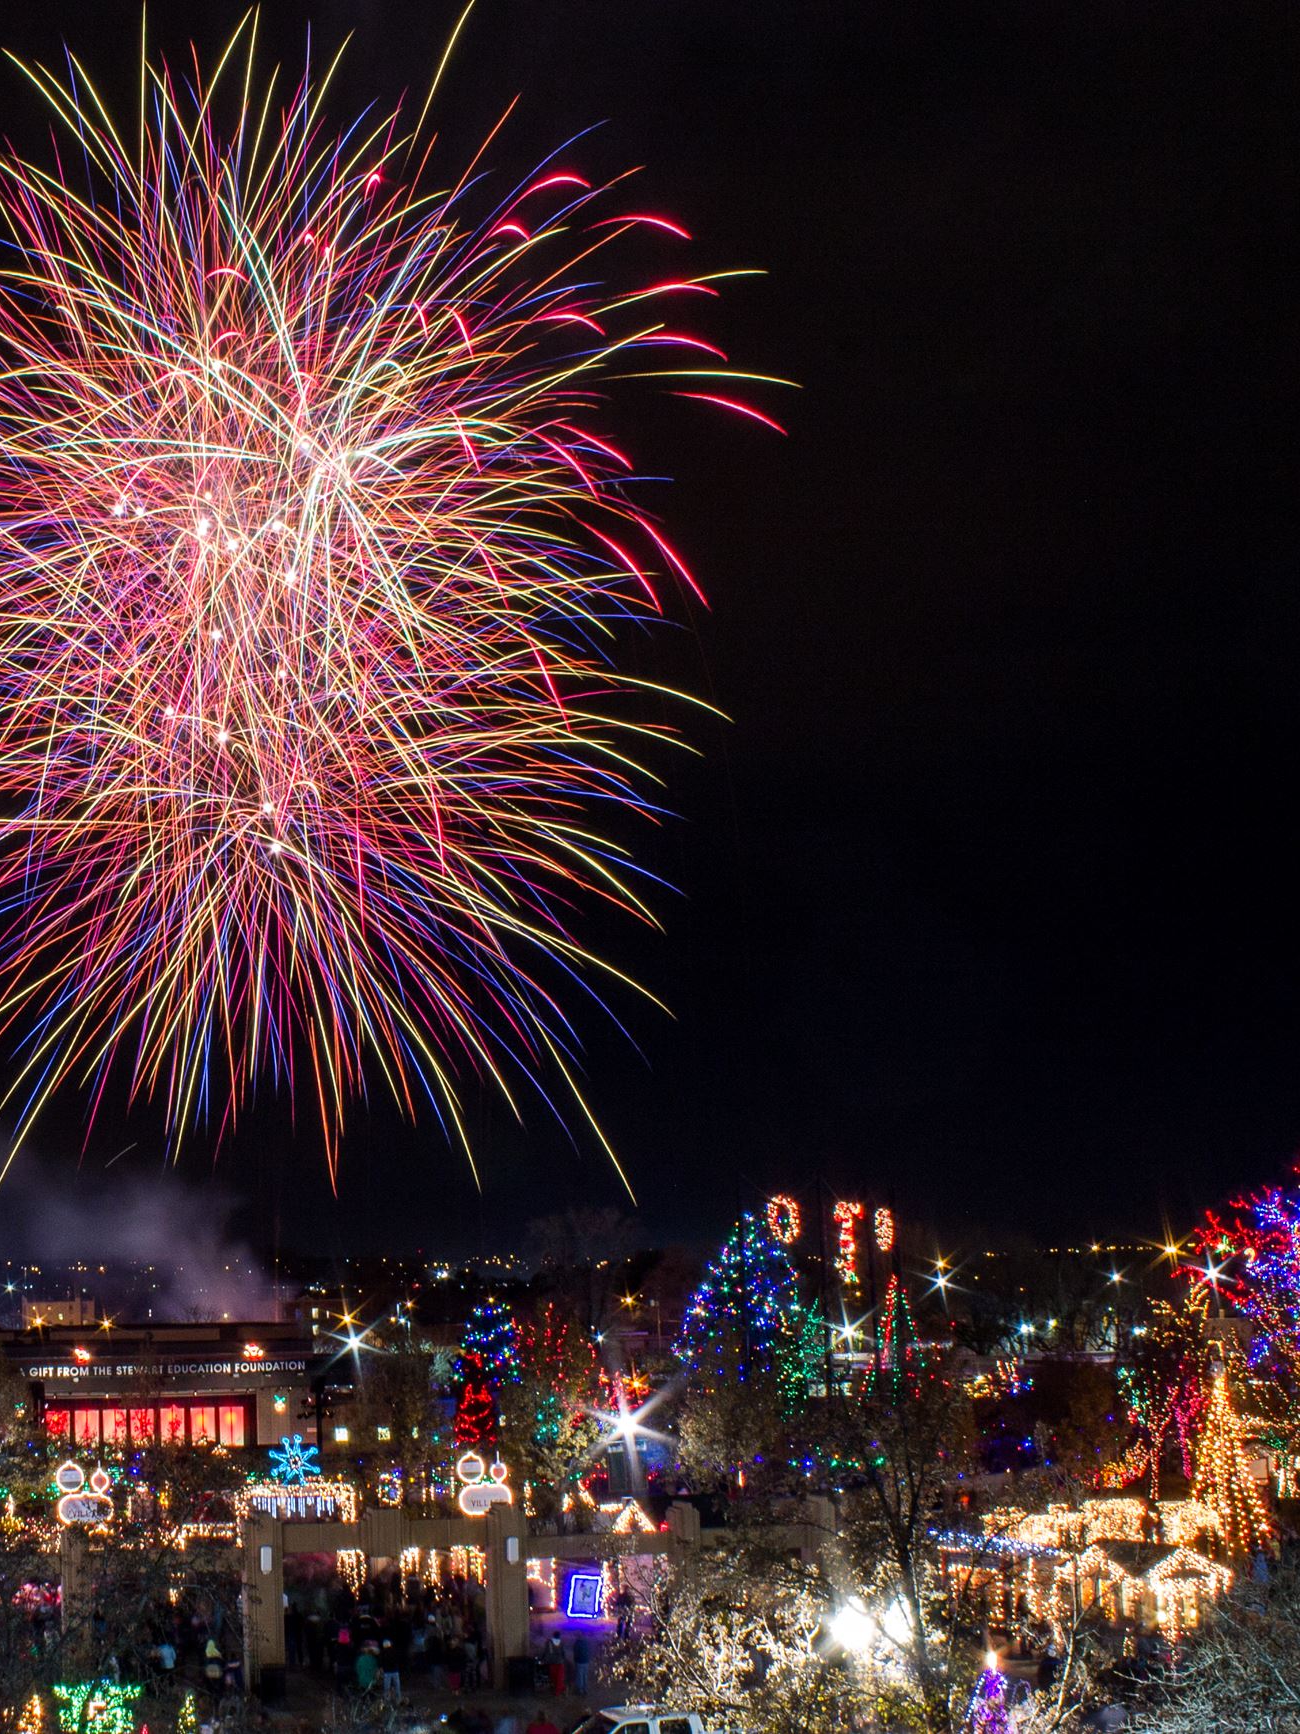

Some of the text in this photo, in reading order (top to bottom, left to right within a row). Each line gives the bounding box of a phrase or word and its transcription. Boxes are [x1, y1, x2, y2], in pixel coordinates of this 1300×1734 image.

[29, 1367, 53, 1377] GIFT
[57, 1366, 89, 1377] FROM
[93, 1366, 112, 1375] THE
[168, 1363, 231, 1374] EDUCATION
[235, 1361, 306, 1373] FOUNDATION
